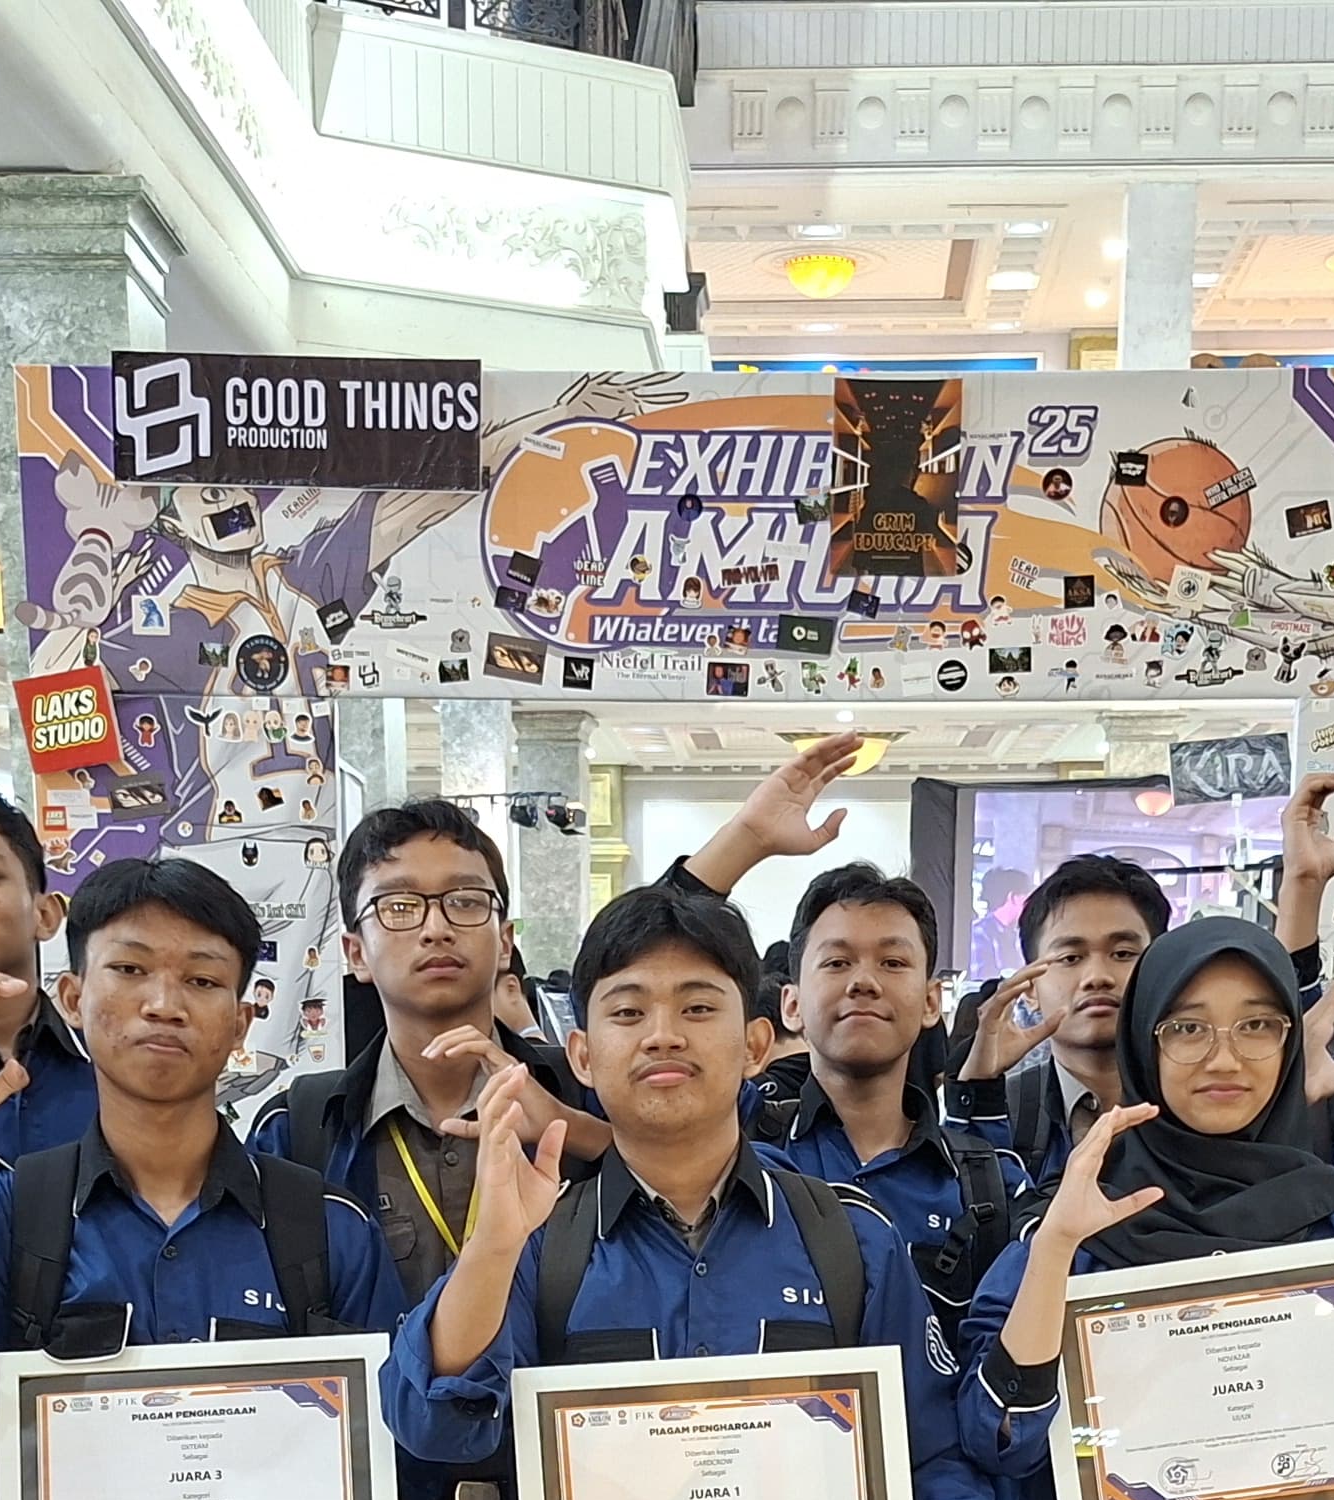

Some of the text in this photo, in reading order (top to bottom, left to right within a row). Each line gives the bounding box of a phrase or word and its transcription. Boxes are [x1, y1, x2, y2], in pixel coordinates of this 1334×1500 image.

[225, 377, 480, 432] GOOD THINGS
[227, 427, 328, 449] PRODUCTION
[873, 513, 915, 532] GRIM
[854, 533, 938, 551] EDUSCAPE
[576, 560, 605, 572] DEAD
[1011, 557, 1039, 575] DEAD
[580, 573, 604, 587] LINE
[1010, 572, 1035, 590] LINE
[593, 620, 724, 642] Whatever
[1270, 620, 1313, 634] GHOSTMAZE
[600, 652, 703, 671] Niefel Trail
[34, 688, 95, 722] LAKS
[34, 715, 104, 750] STUDIO
[1175, 748, 1285, 798] KIRA
[928, 1214, 951, 1231] SI
[782, 1286, 824, 1305] SIJ
[1169, 1312, 1292, 1337] PIAGAM PENGHARGAAN
[1212, 1379, 1265, 1396] JUARA 3
[131, 1406, 257, 1422] PIAGAM PENGHARGAAN
[635, 1411, 655, 1422] FIK
[649, 1420, 772, 1437] PIAGAM PENGHARGAAN
[169, 1470, 222, 1483] JUARA 3
[689, 1486, 741, 1500] JUARA 1
